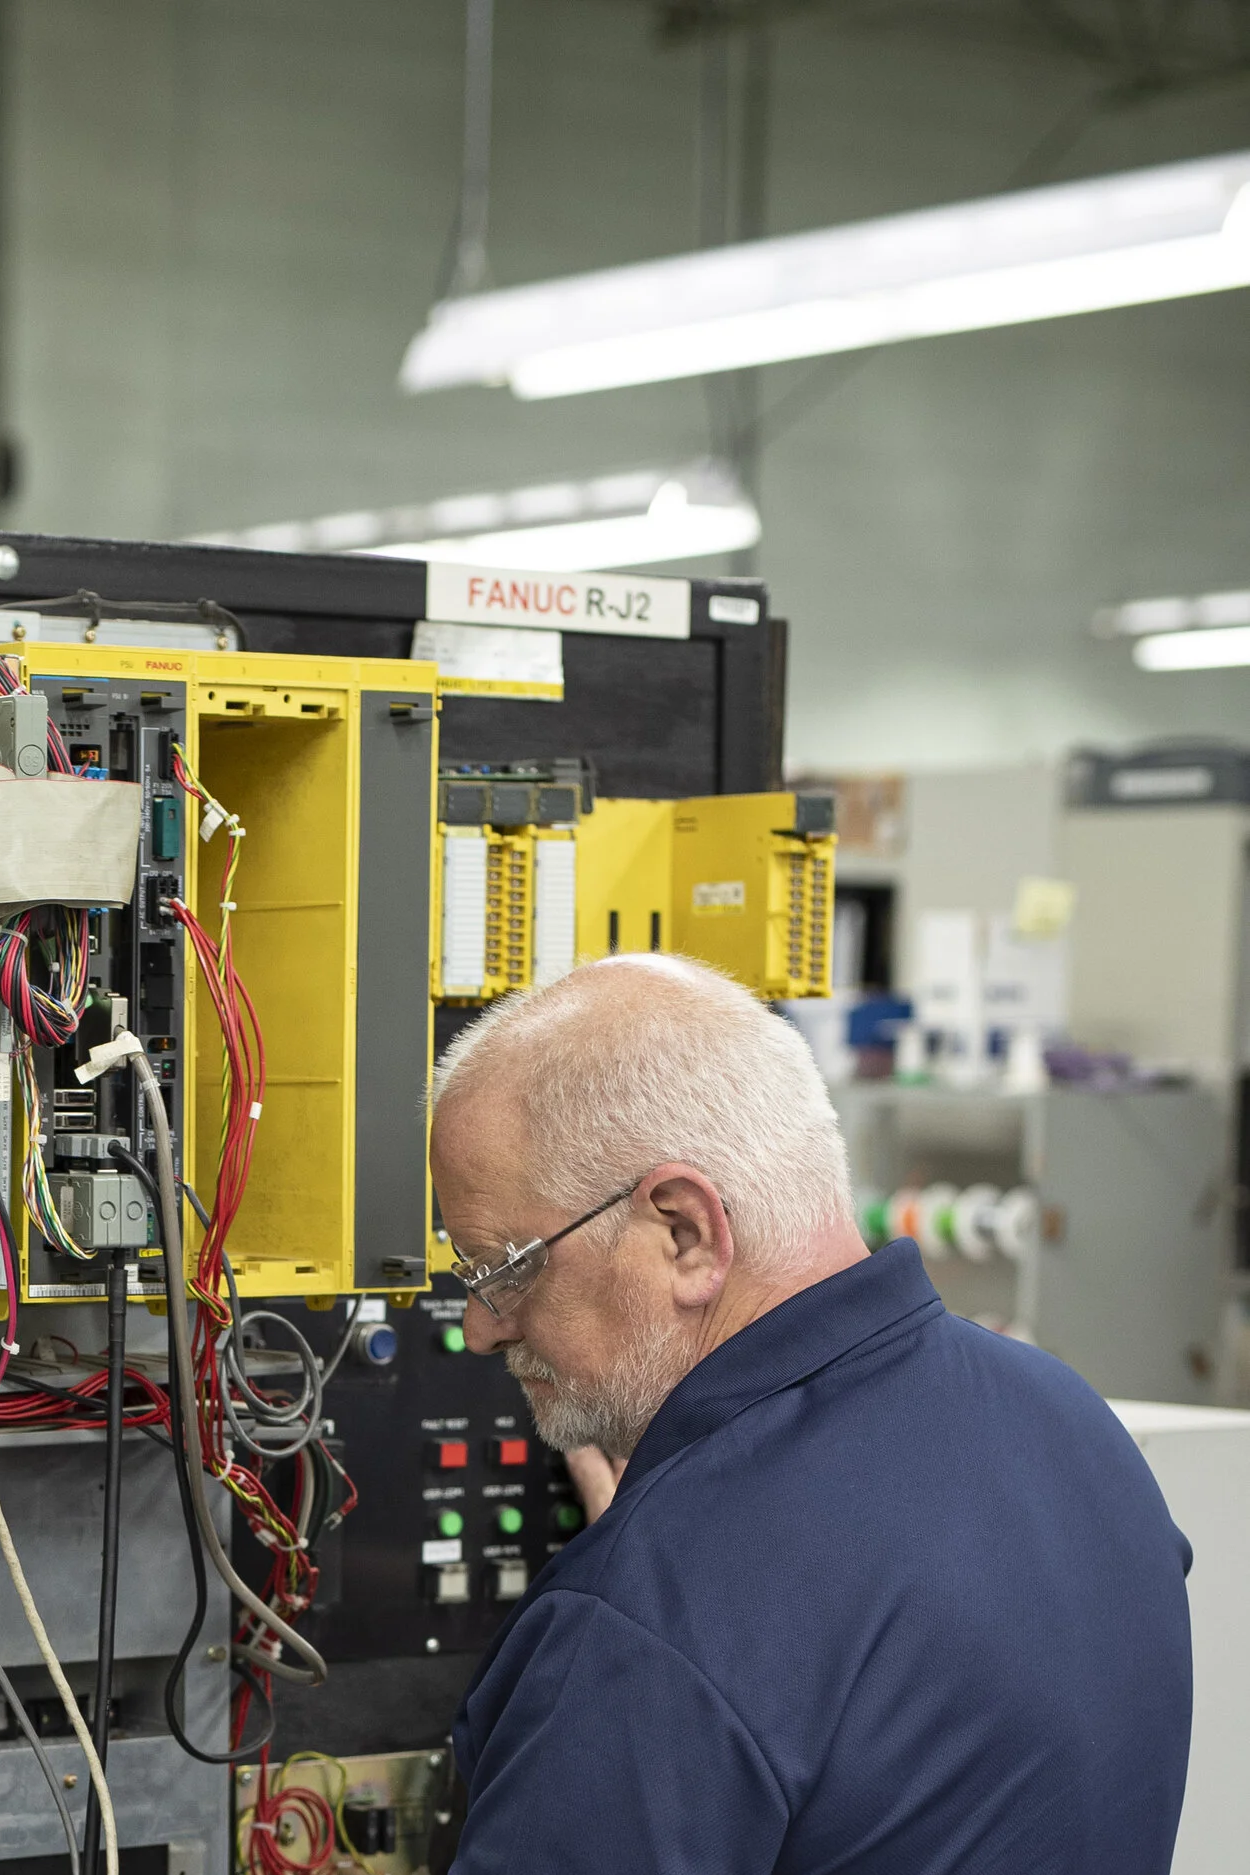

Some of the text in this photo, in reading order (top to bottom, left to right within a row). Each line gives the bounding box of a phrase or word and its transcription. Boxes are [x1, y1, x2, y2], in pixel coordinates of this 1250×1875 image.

[467, 577, 652, 622] FANUC R-J2
[145, 661, 183, 671] FANUC
